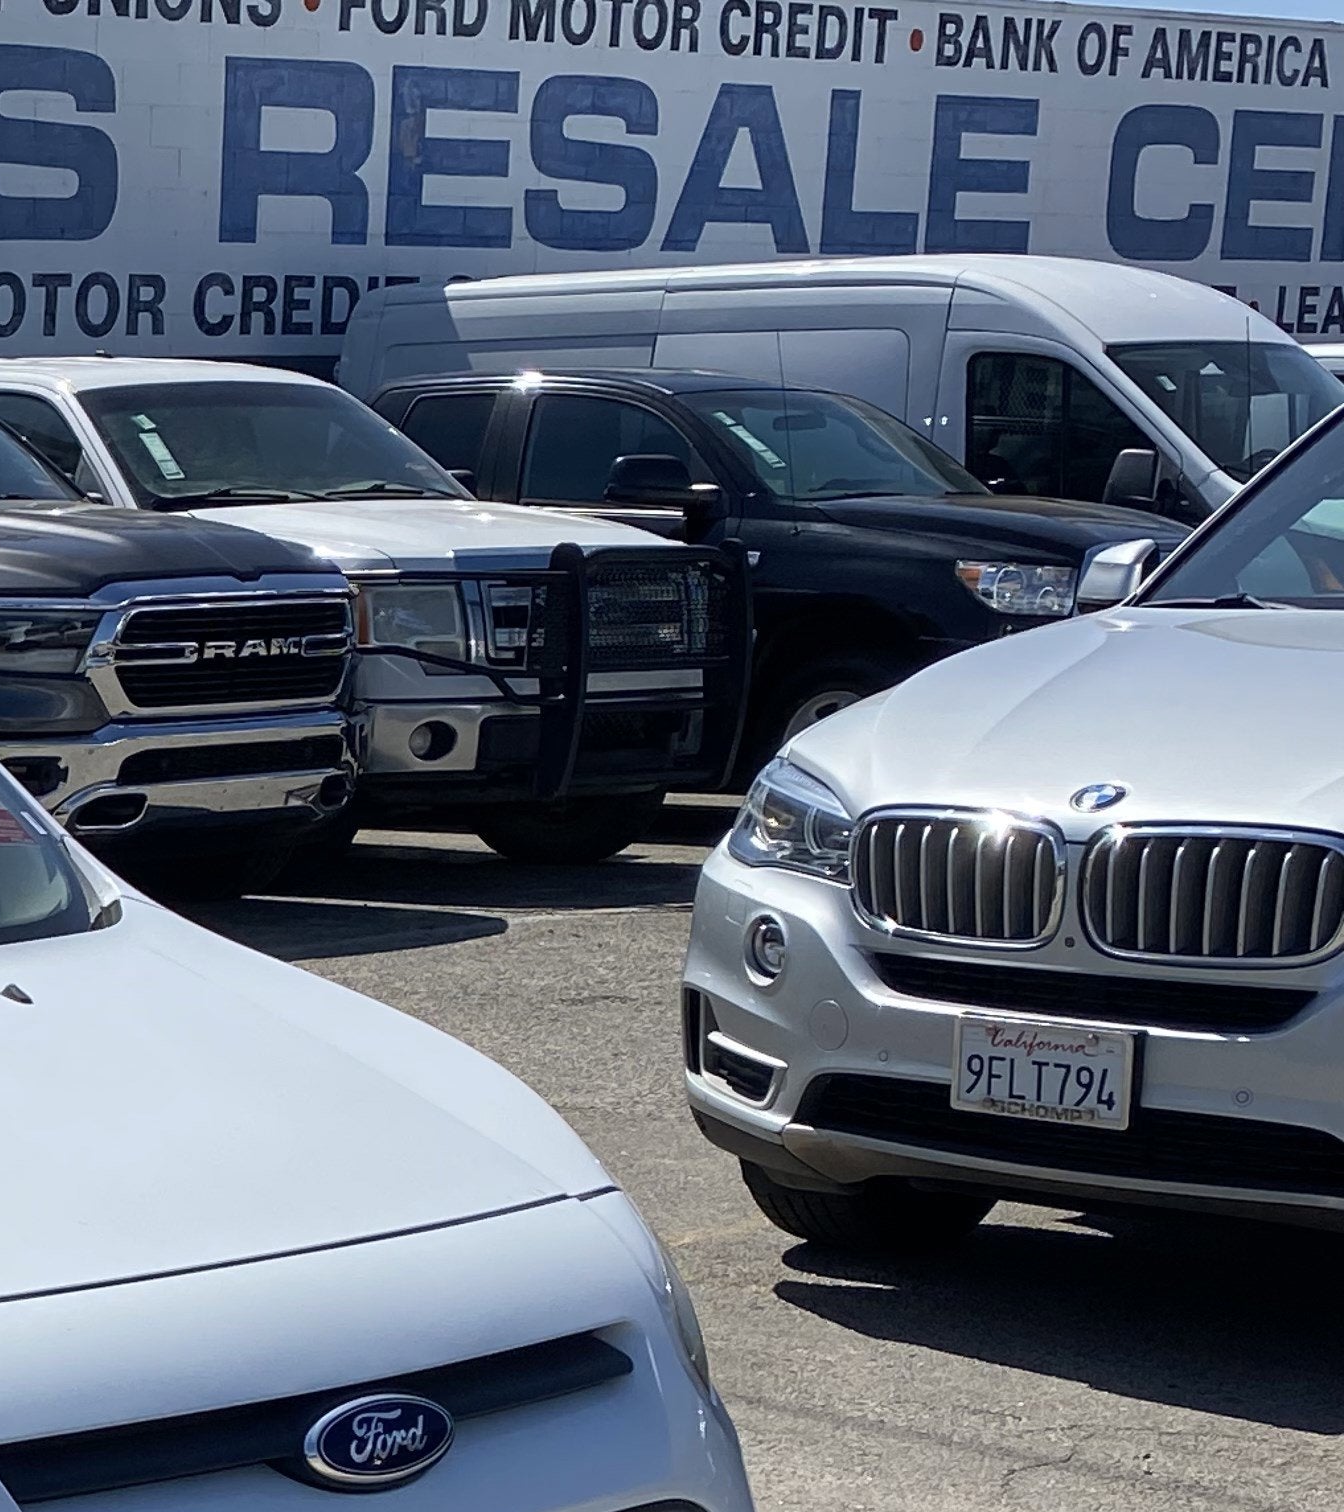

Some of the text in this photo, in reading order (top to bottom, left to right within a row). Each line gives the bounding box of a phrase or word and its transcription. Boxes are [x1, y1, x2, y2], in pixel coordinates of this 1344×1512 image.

[339, 0, 489, 37] FORD
[508, 0, 702, 52] MOTOR
[719, 0, 899, 64] CREDIT
[934, 13, 1060, 74] BANK
[1077, 23, 1133, 77] OF
[1141, 26, 1331, 88] AMERICA
[219, 55, 1040, 255] RESALE
[1106, 103, 1344, 263] CE
[193, 271, 420, 337] CRED
[203, 637, 300, 659] RAM
[990, 1028, 1096, 1057] California
[965, 1053, 1116, 1111] 9FLT794
[350, 1408, 429, 1464] Ford
